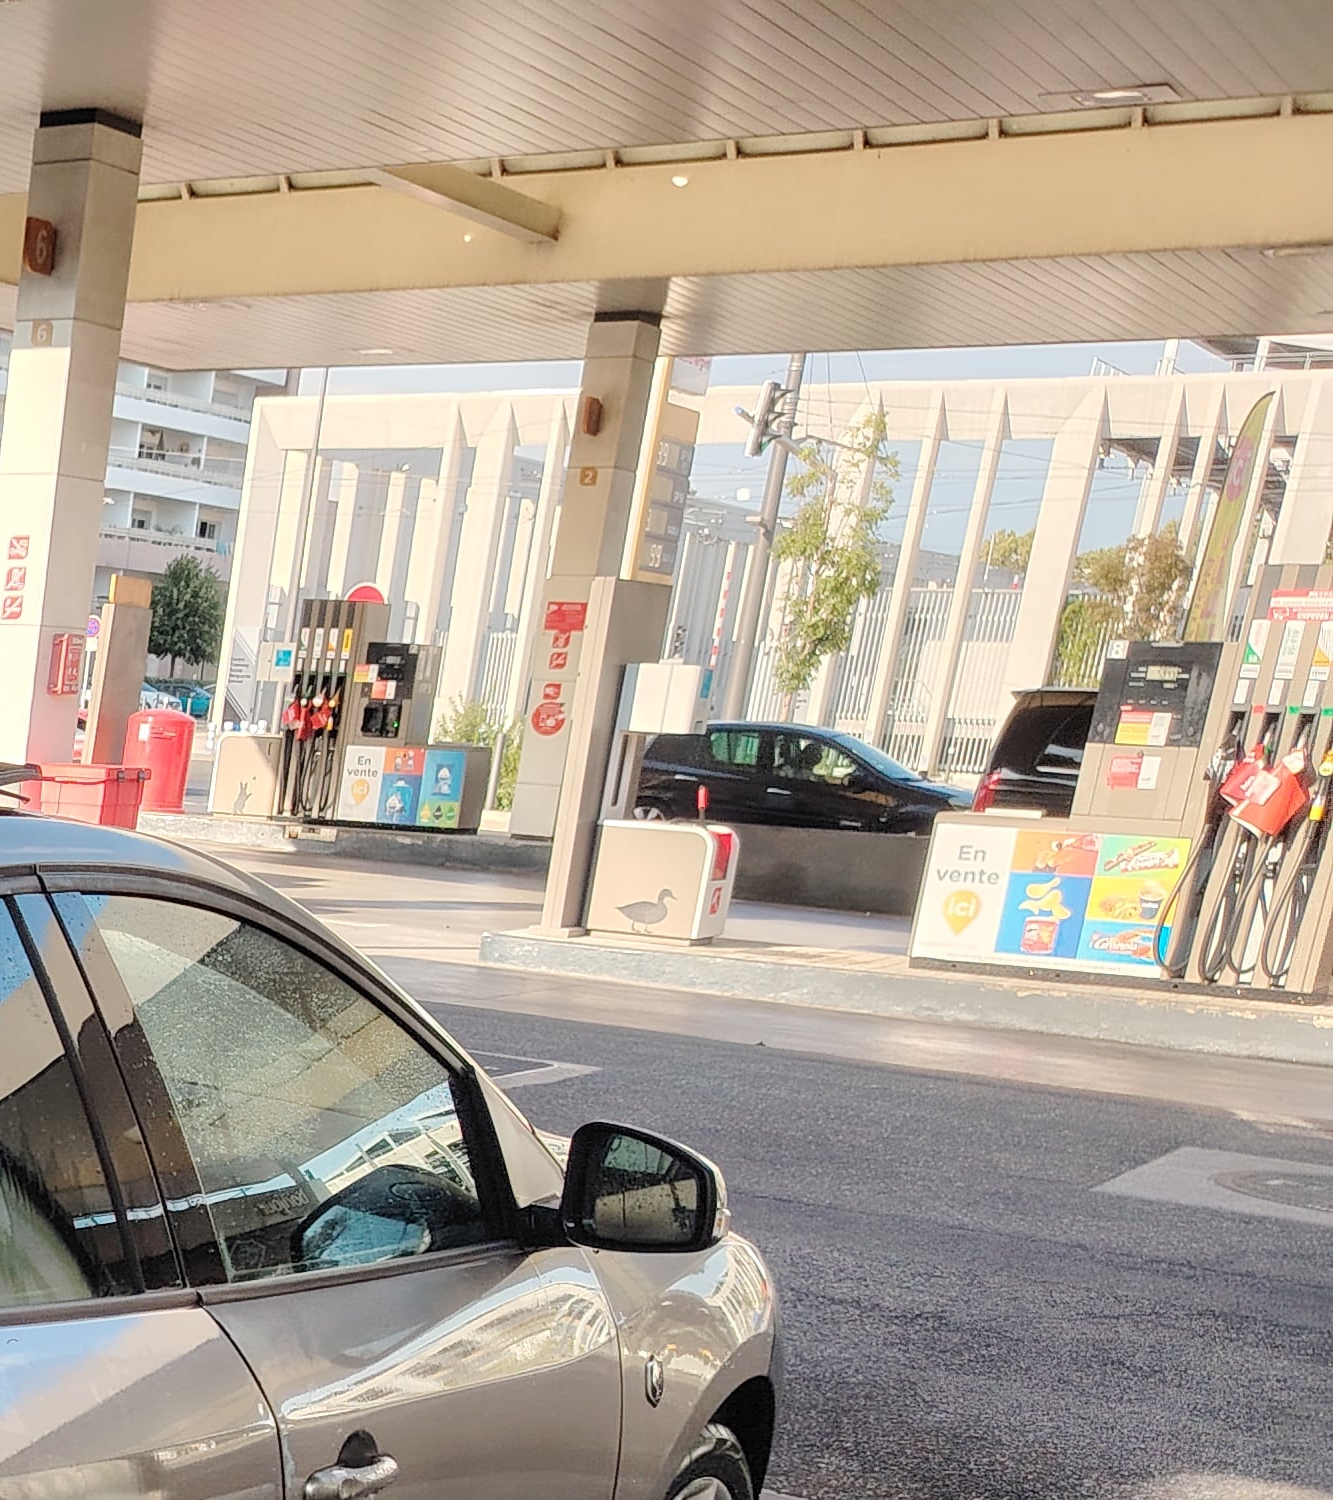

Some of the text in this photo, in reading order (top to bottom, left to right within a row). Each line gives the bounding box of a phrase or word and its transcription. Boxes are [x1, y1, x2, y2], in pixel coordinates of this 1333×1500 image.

[36, 229, 48, 264] 6
[36, 324, 47, 342] 6
[583, 470, 594, 485] 2
[1111, 641, 1125, 658] 8
[357, 756, 372, 766] En
[347, 768, 378, 778] vente
[958, 844, 987, 862] En
[936, 867, 1000, 886] vente
[947, 897, 976, 918] ici
